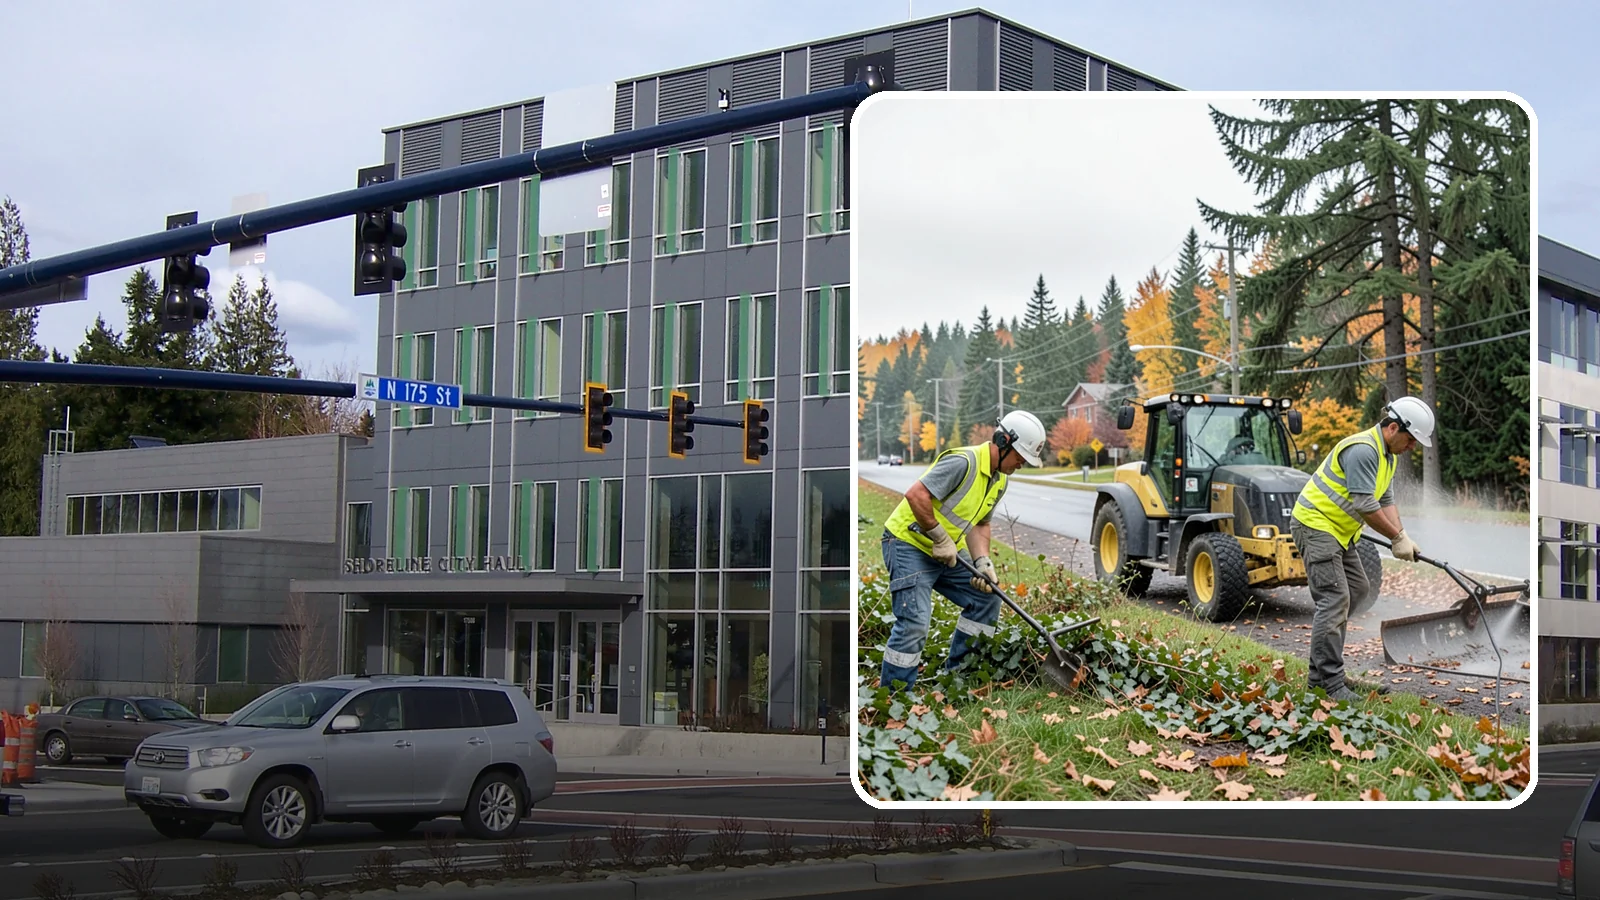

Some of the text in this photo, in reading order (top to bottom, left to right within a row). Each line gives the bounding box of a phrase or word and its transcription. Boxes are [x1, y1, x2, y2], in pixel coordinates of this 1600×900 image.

[387, 380, 451, 406] N 175 St
[344, 555, 525, 574] SHORELINE CITY HALL
